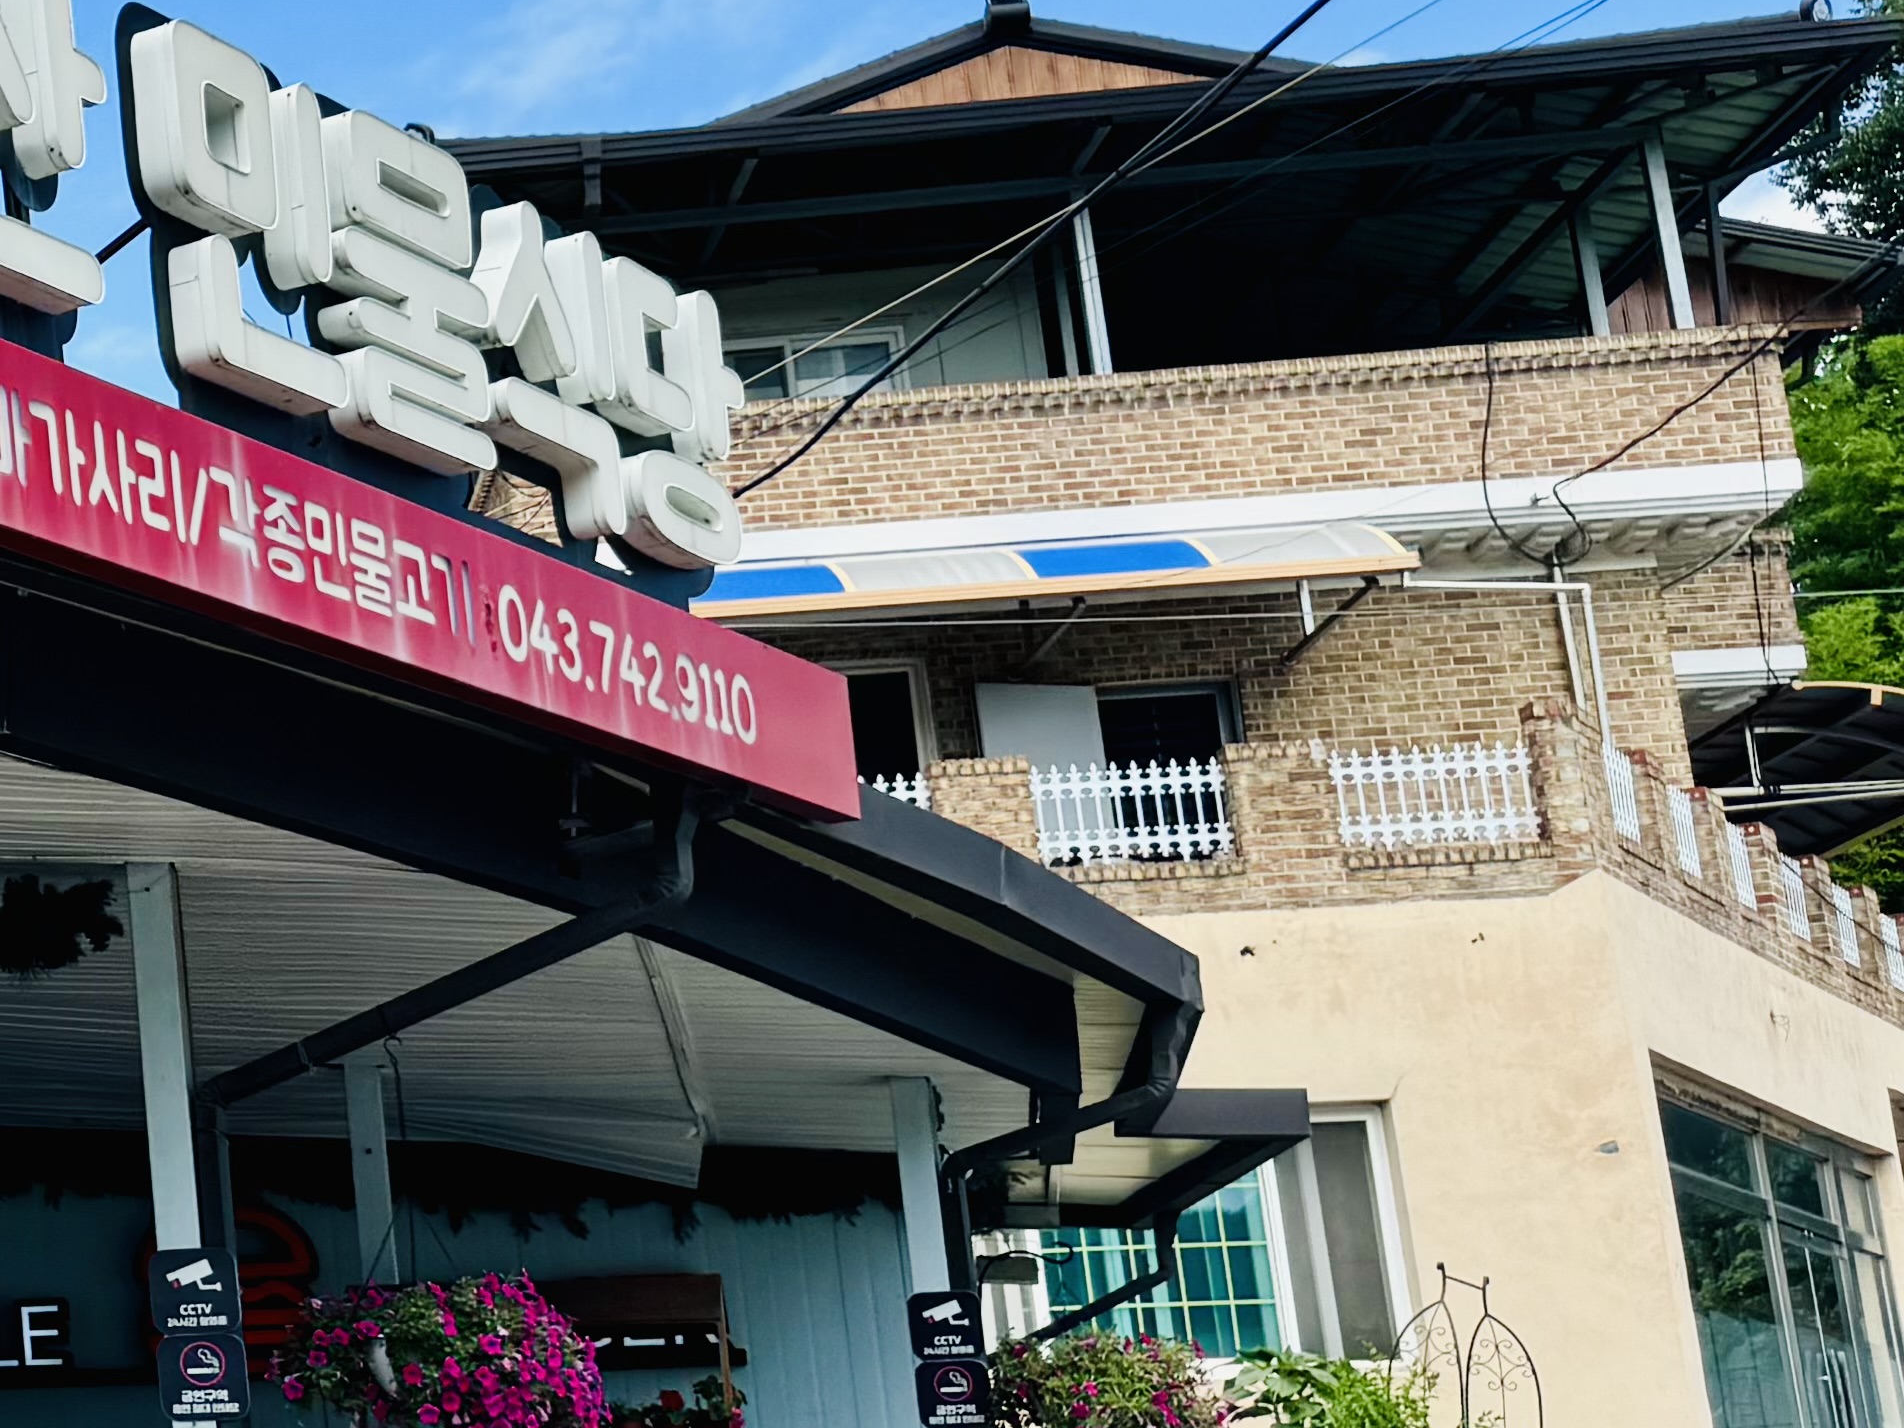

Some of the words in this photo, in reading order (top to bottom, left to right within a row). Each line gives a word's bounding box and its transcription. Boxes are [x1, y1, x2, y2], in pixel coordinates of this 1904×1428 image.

[130, 19, 745, 569] 민물식당
[498, 583, 756, 744] 043.742.9110
[179, 1303, 212, 1316] CCTV
[934, 1335, 962, 1345] CCTV
